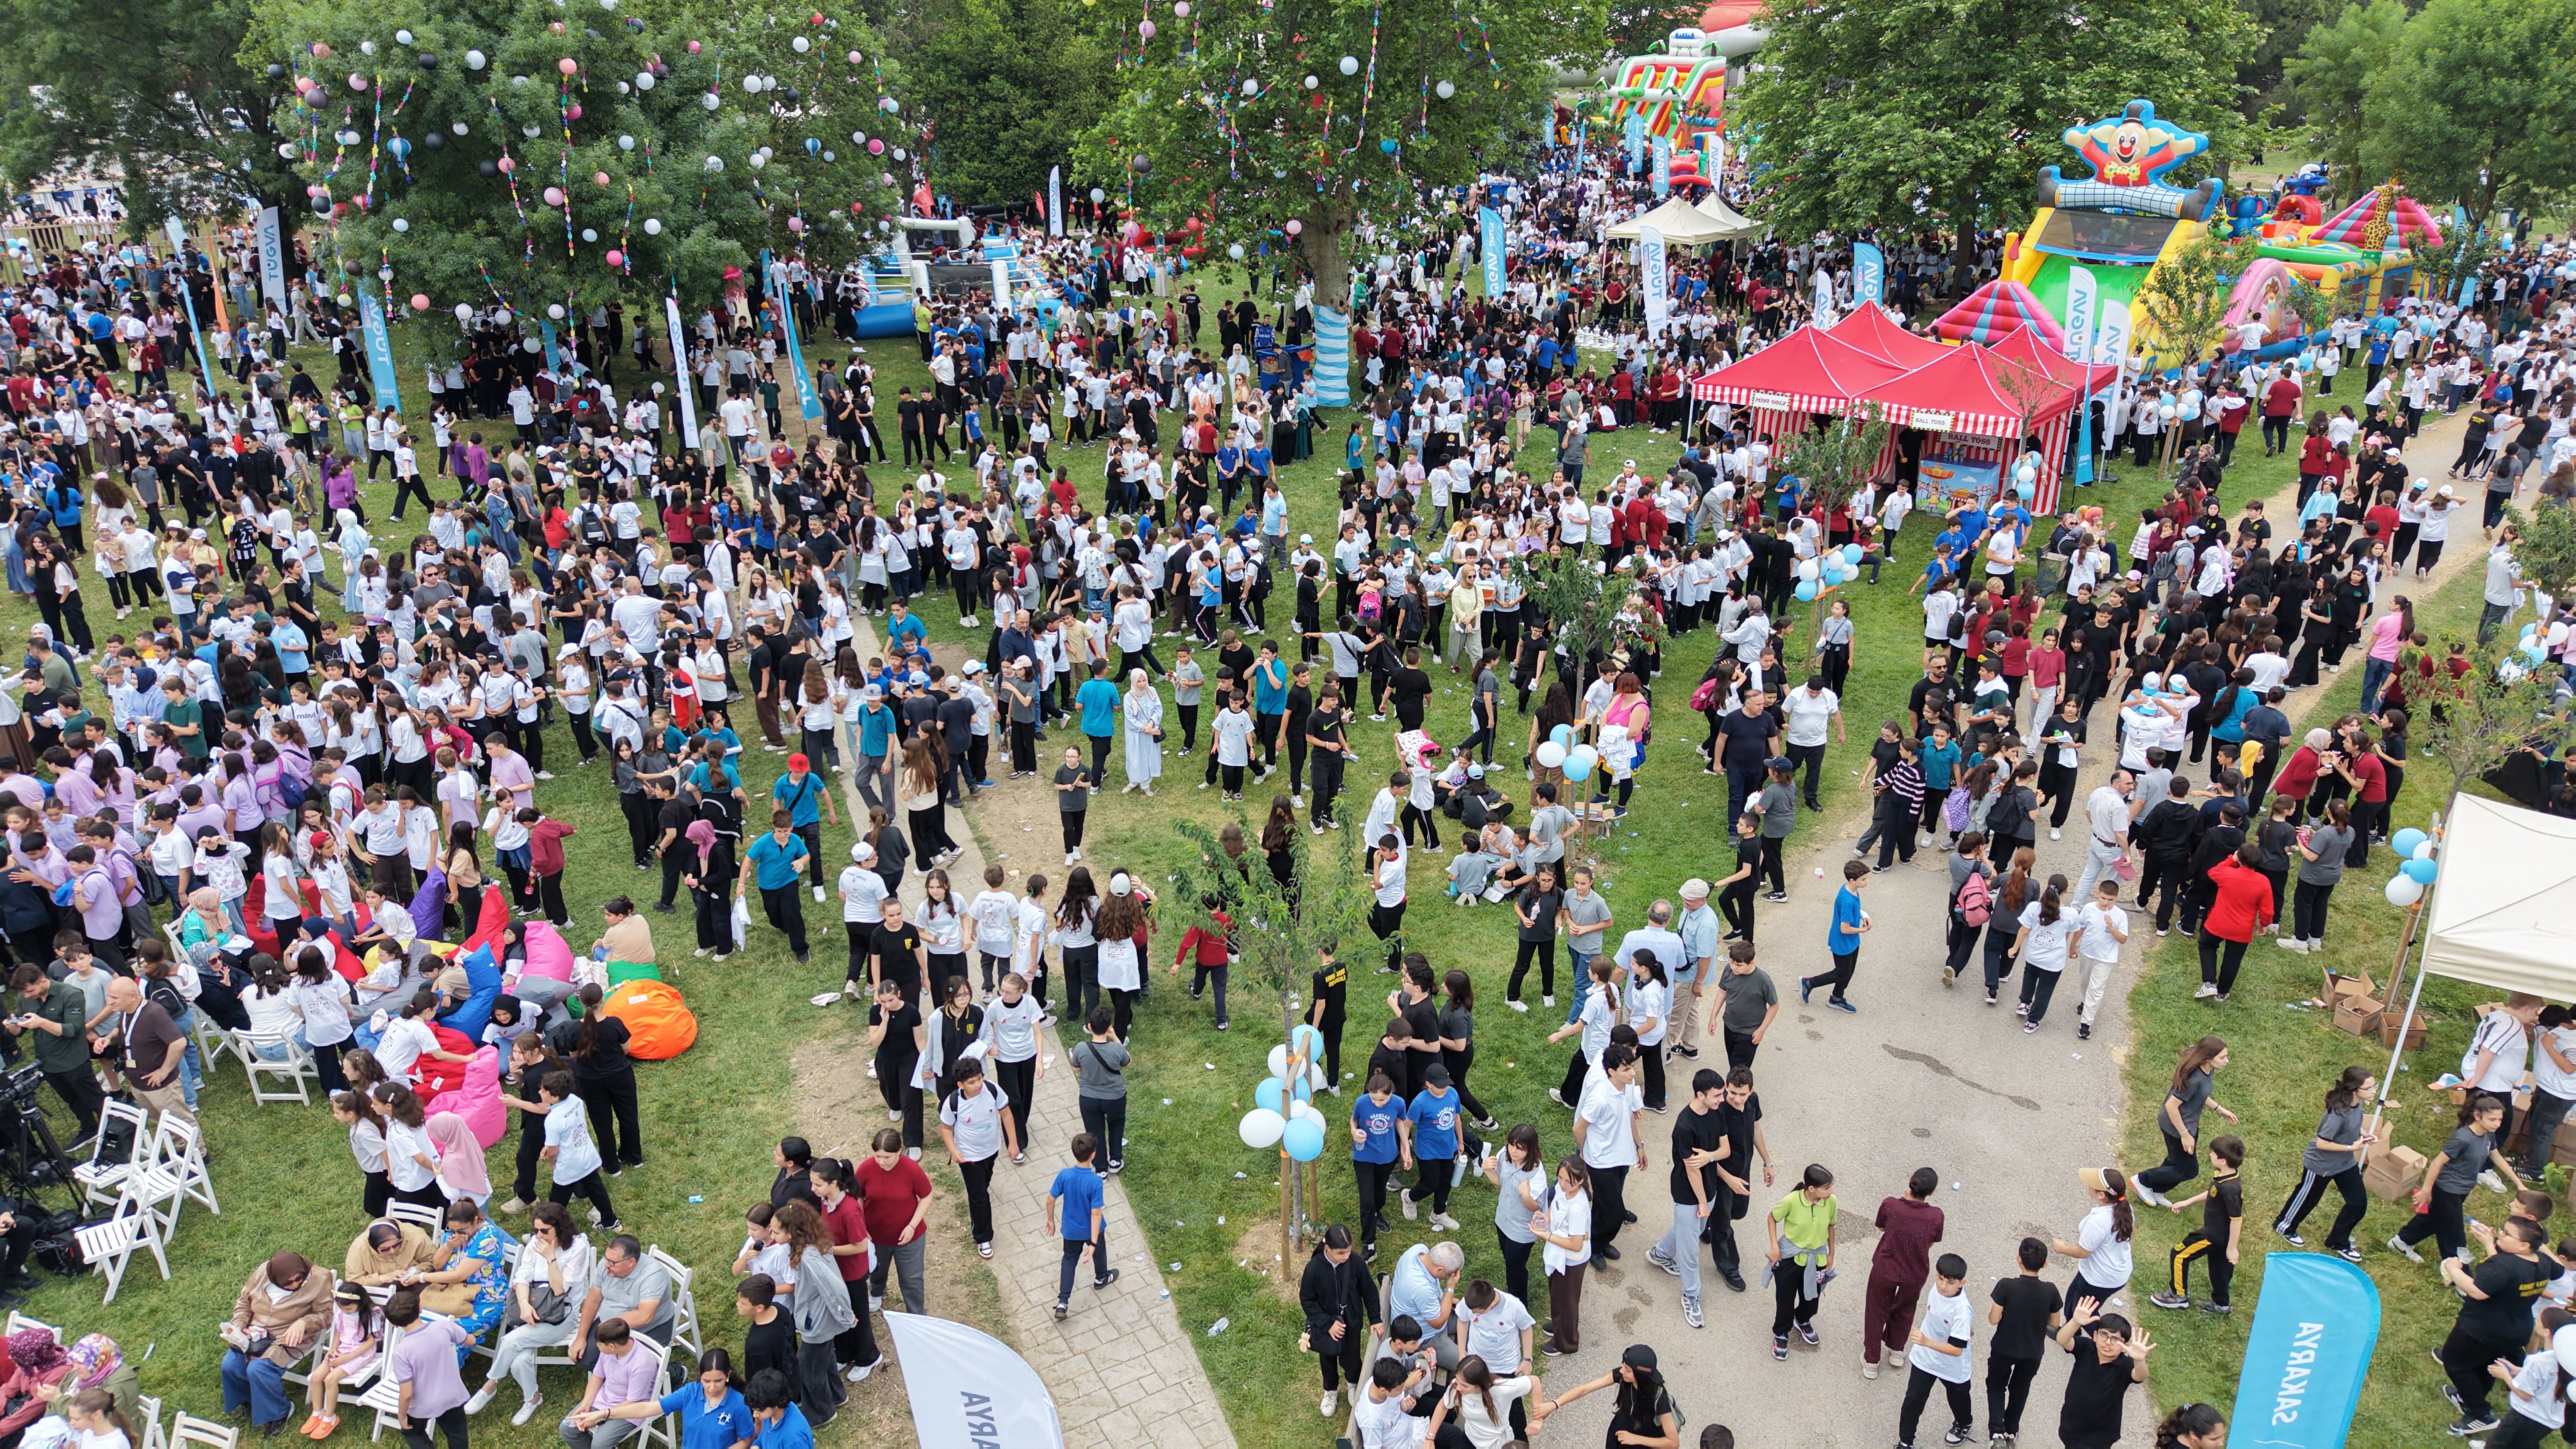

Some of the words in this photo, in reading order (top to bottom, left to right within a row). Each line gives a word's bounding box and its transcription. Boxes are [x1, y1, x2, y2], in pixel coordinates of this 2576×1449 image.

[263, 224, 278, 282] TÜGVA
[1948, 433, 1968, 442] BALL
[1971, 436, 1991, 445] TOSS
